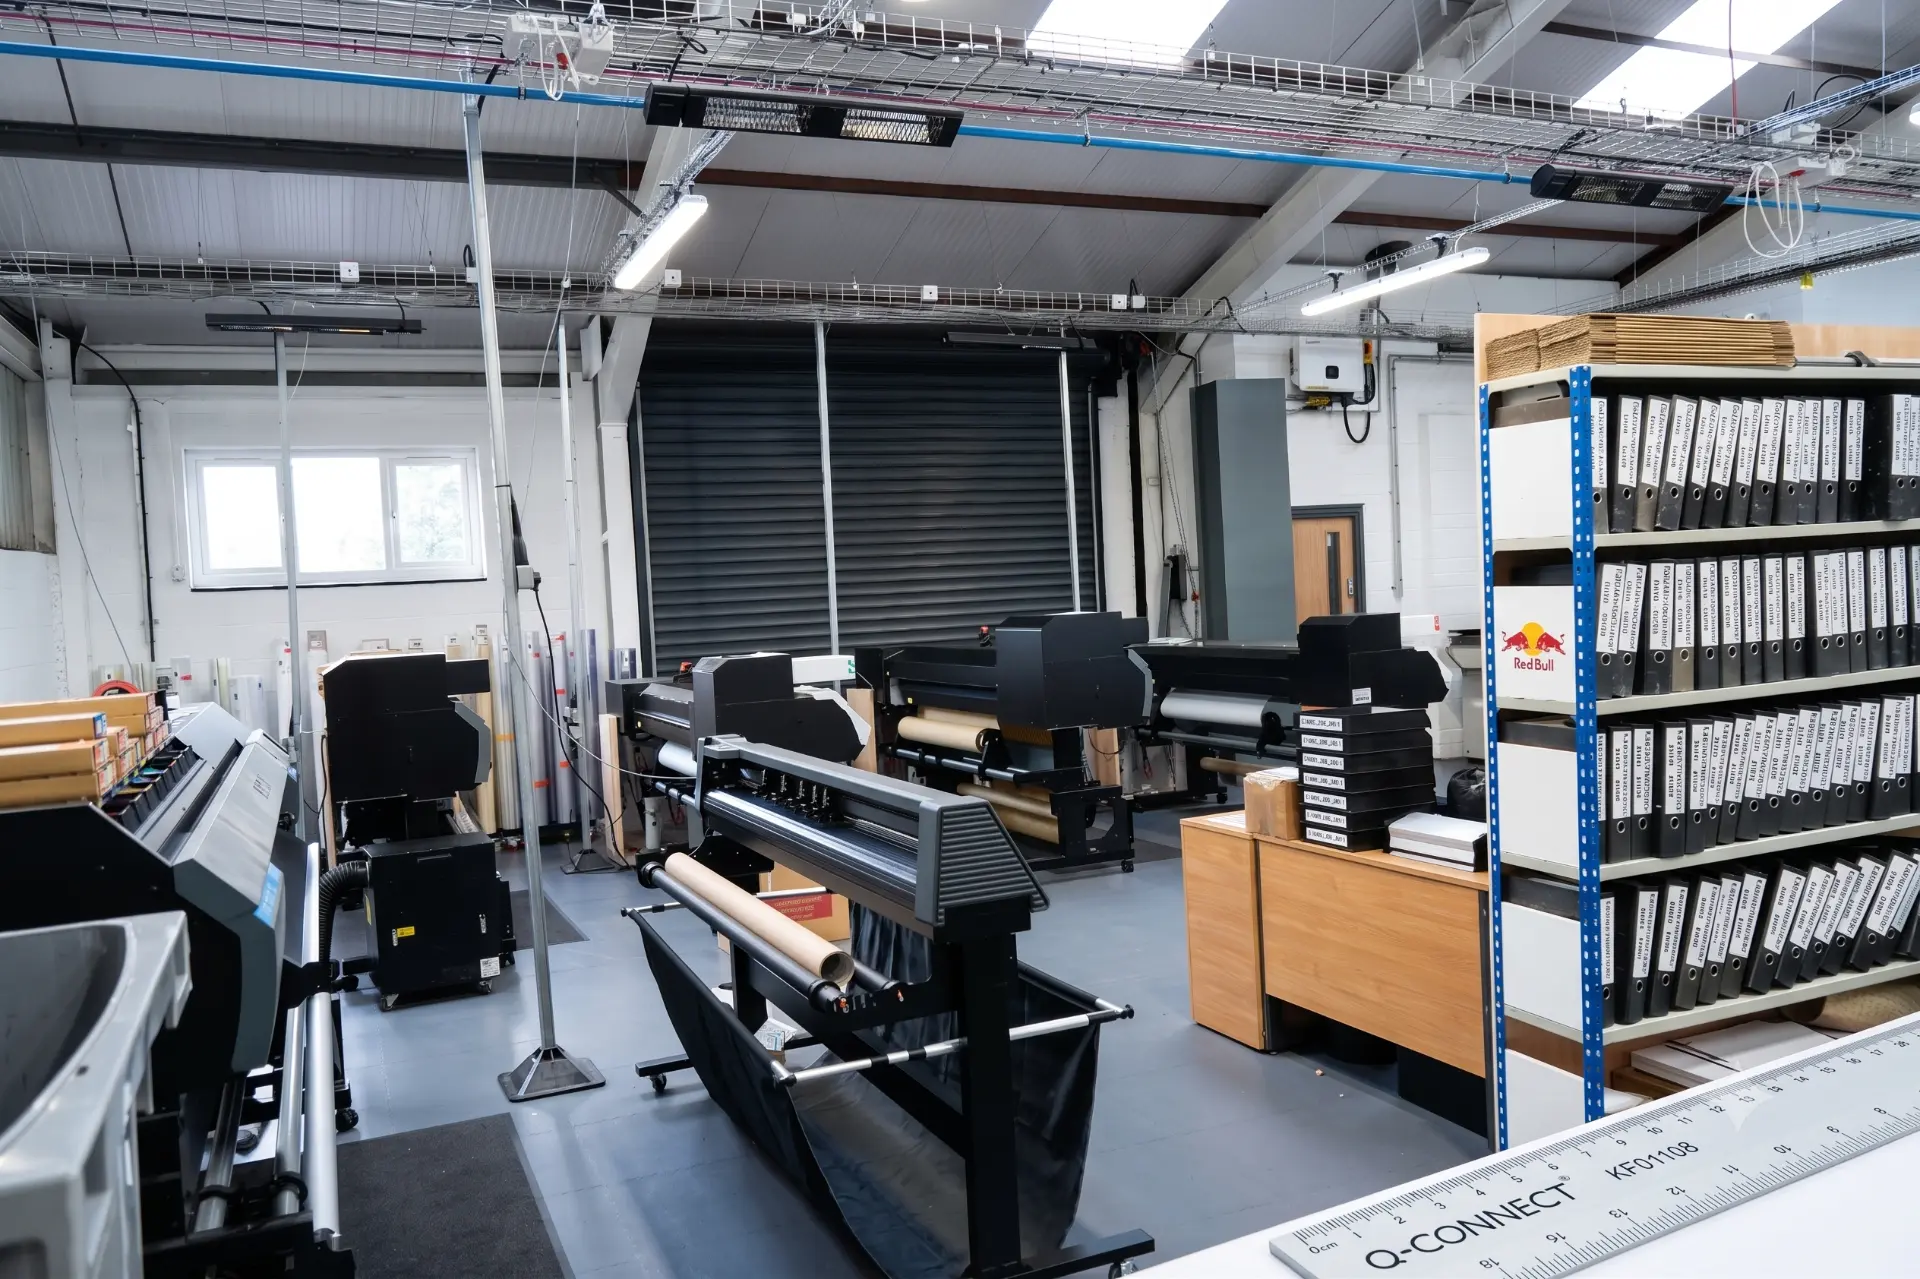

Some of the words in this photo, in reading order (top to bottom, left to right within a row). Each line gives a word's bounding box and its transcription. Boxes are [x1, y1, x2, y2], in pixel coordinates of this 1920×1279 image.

[1514, 657, 1533, 670] Red
[1534, 658, 1554, 672] Bull
[1393, 1215, 1406, 1225] 2
[1434, 1202, 1447, 1210] 3
[1475, 1189, 1486, 1197] 4
[1511, 1175, 1523, 1184] 5
[1547, 1162, 1559, 1171] 6
[1580, 1149, 1592, 1158] 7
[1647, 1126, 1663, 1135] 10
[1677, 1116, 1693, 1125] 11
[1709, 1104, 1726, 1114] 12
[1819, 1066, 1837, 1075] 15
[1773, 1144, 1792, 1154] 10
[1605, 1141, 1699, 1181] KF01108
[1722, 1164, 1740, 1174] 11
[1666, 1185, 1686, 1196] 12
[1608, 1208, 1629, 1219] 13
[1545, 1232, 1566, 1243] 16
[1479, 1257, 1500, 1269] 18
